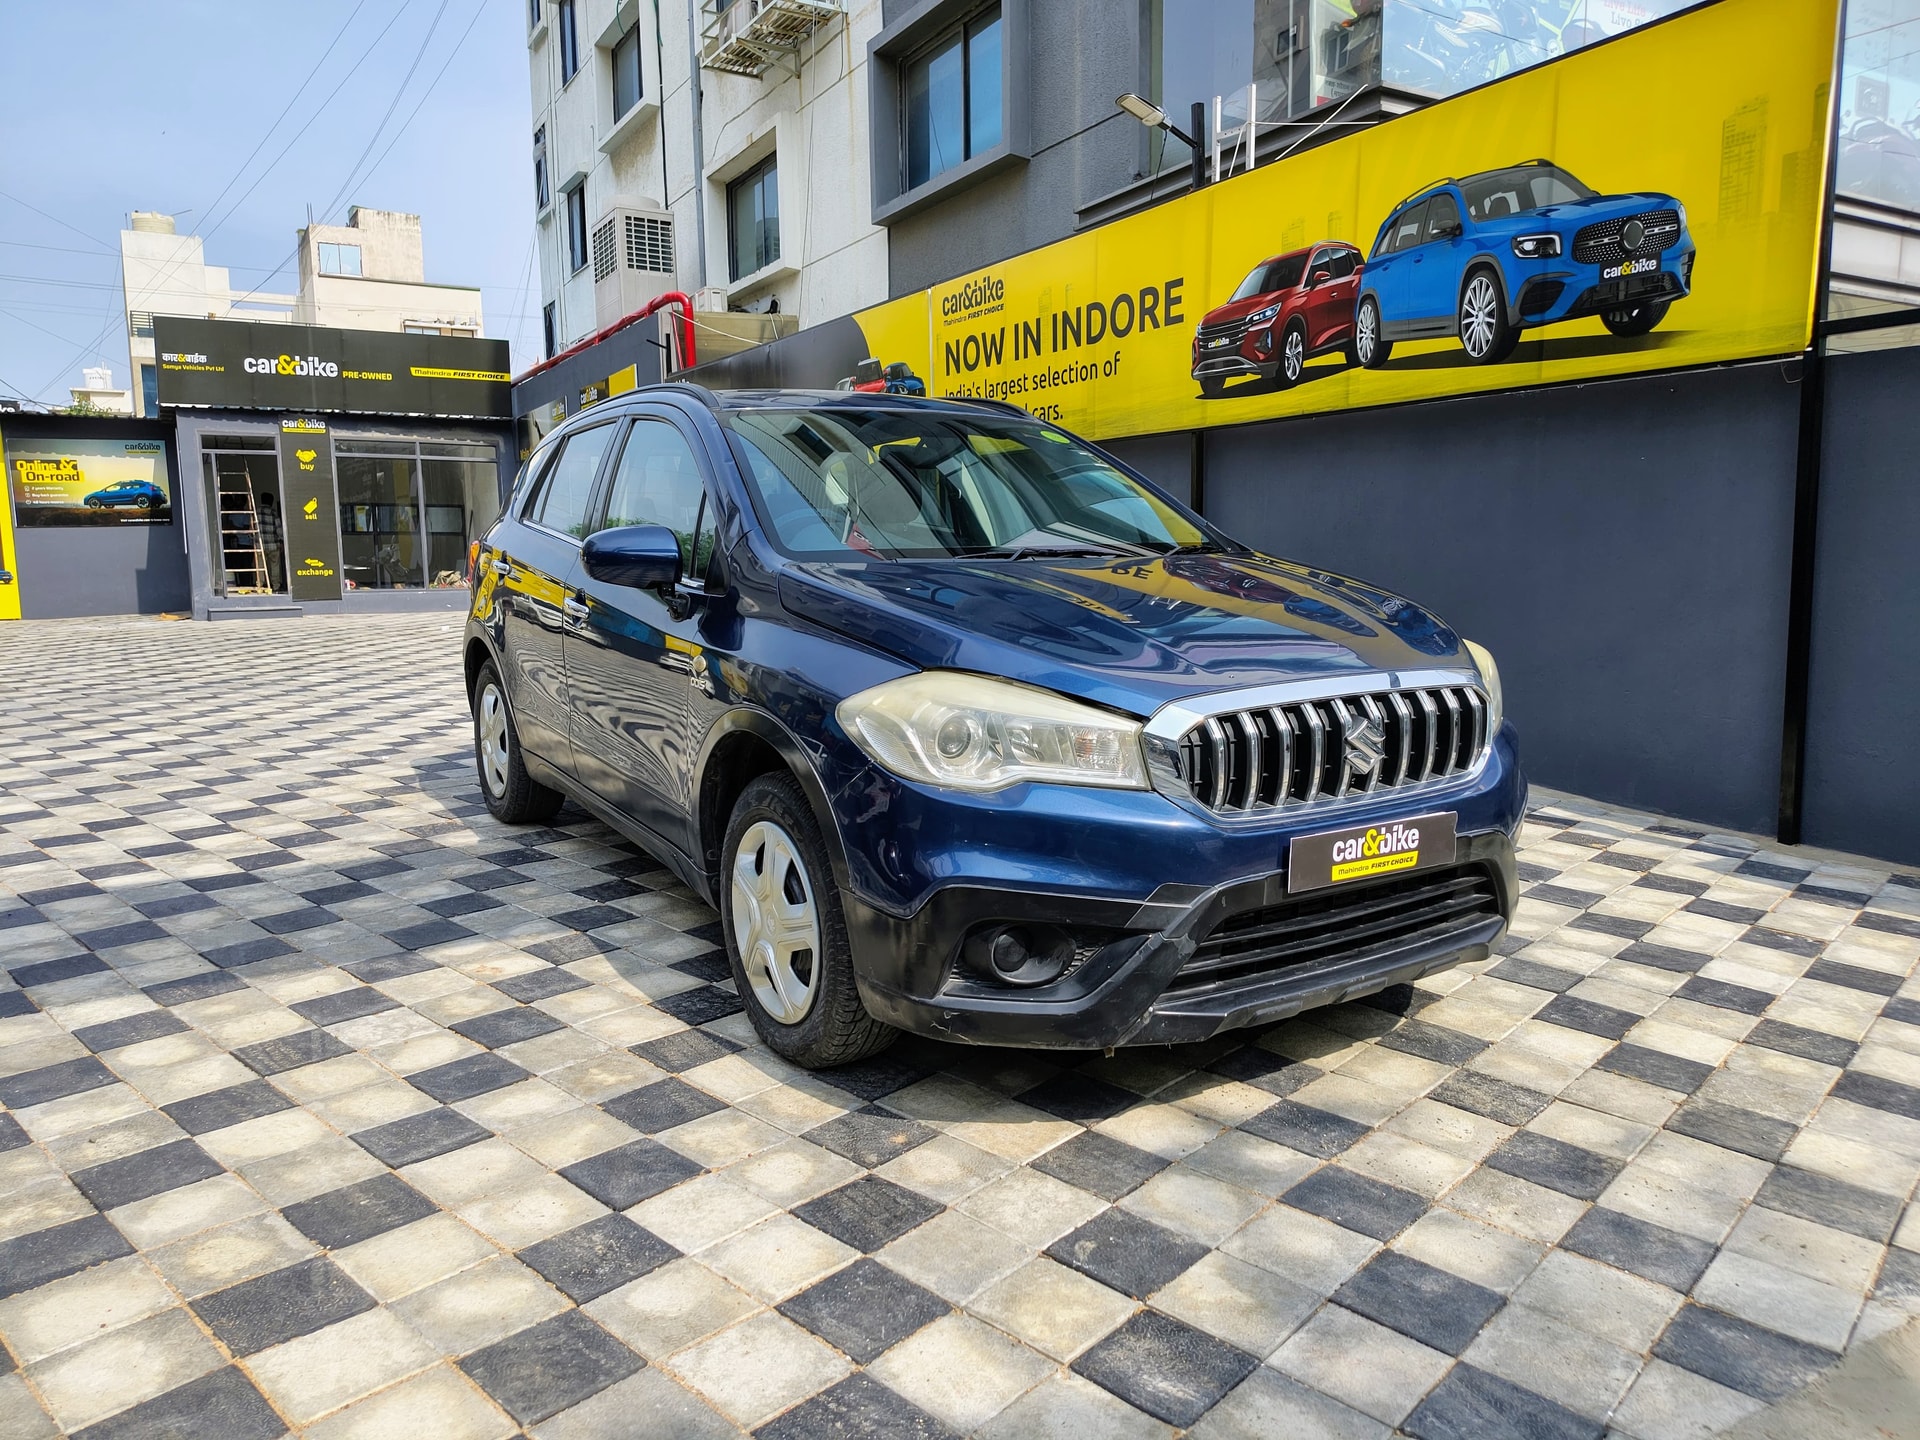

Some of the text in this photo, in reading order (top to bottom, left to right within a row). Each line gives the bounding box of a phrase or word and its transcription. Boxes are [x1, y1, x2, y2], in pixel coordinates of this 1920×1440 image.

[1603, 258, 1657, 278] car&bike
[942, 275, 1004, 317] car&bike
[943, 303, 1004, 326] Mahindra FIRST CHOICE
[945, 277, 1184, 377] NOW IN INDORE
[244, 354, 392, 381] car&bike PRE-OWNED
[414, 369, 451, 377] Mahindra
[985, 373, 1028, 401] largest
[1032, 359, 1098, 390] selection
[1103, 351, 1121, 377] of
[282, 418, 326, 428] car&bike
[124, 442, 161, 451] car&bike
[16, 457, 77, 472] Online &
[300, 462, 315, 471] buy
[26, 471, 80, 482] On-road
[297, 568, 333, 577] exchange
[1332, 824, 1420, 862] car&bike
[1338, 856, 1415, 876] Mahindra FIRST CHOICE
